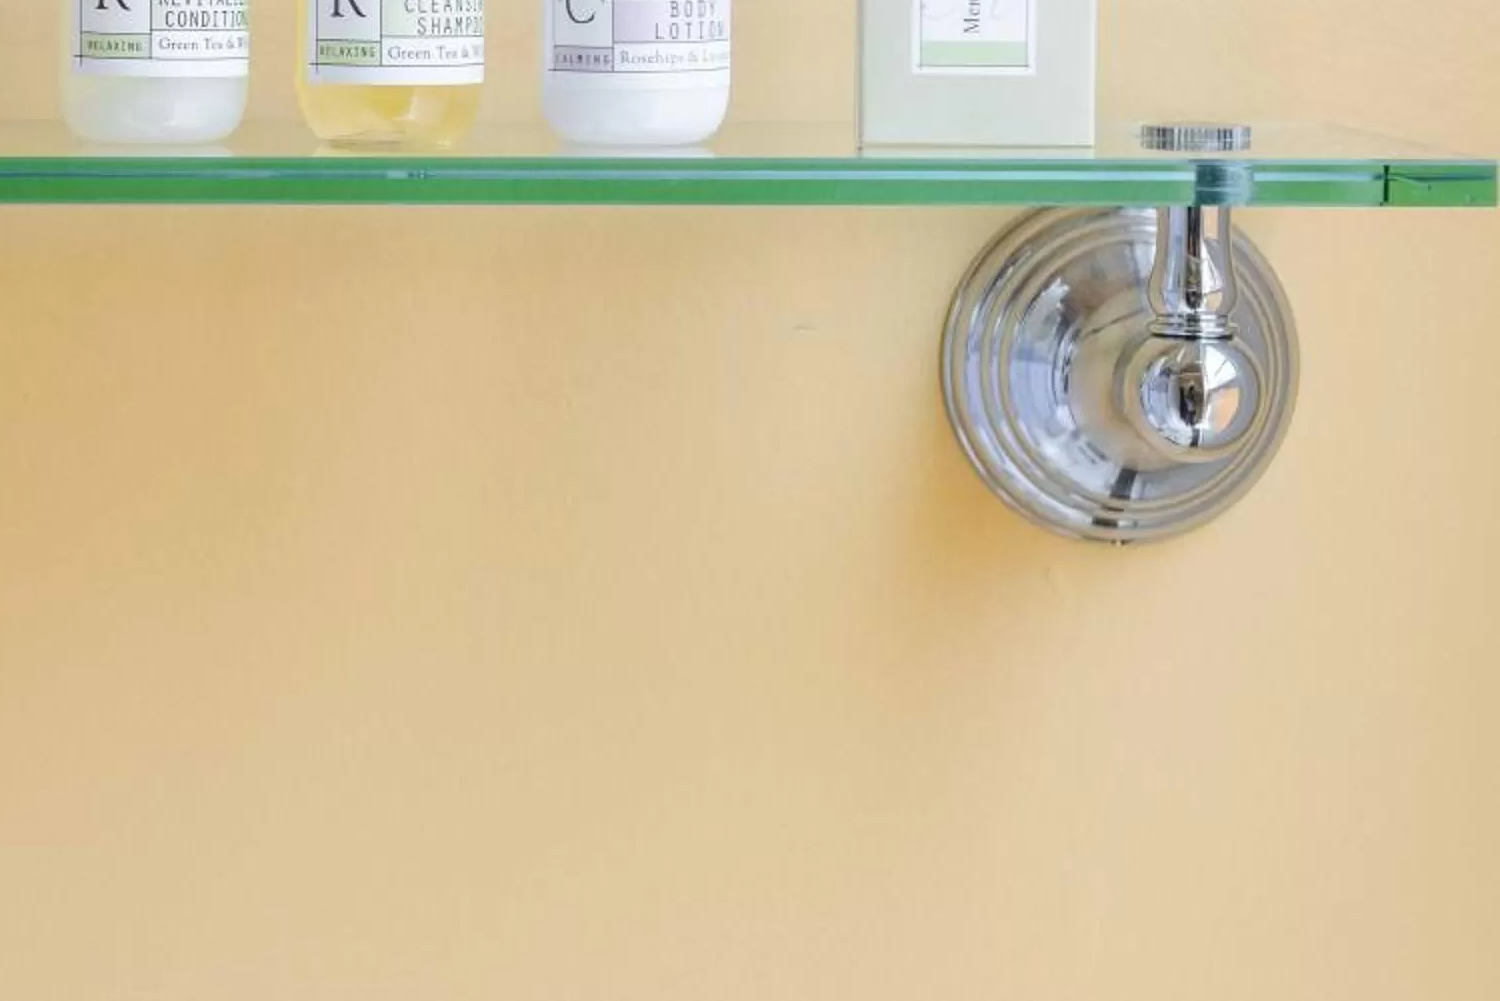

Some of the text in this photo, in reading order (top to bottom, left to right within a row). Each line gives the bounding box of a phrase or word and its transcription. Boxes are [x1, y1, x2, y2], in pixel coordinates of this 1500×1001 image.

[669, 0, 717, 18] BODY
[87, 39, 142, 52] RELAXING
[158, 37, 198, 51] Green
[319, 45, 377, 57] RELAXING
[387, 46, 432, 60] Green
